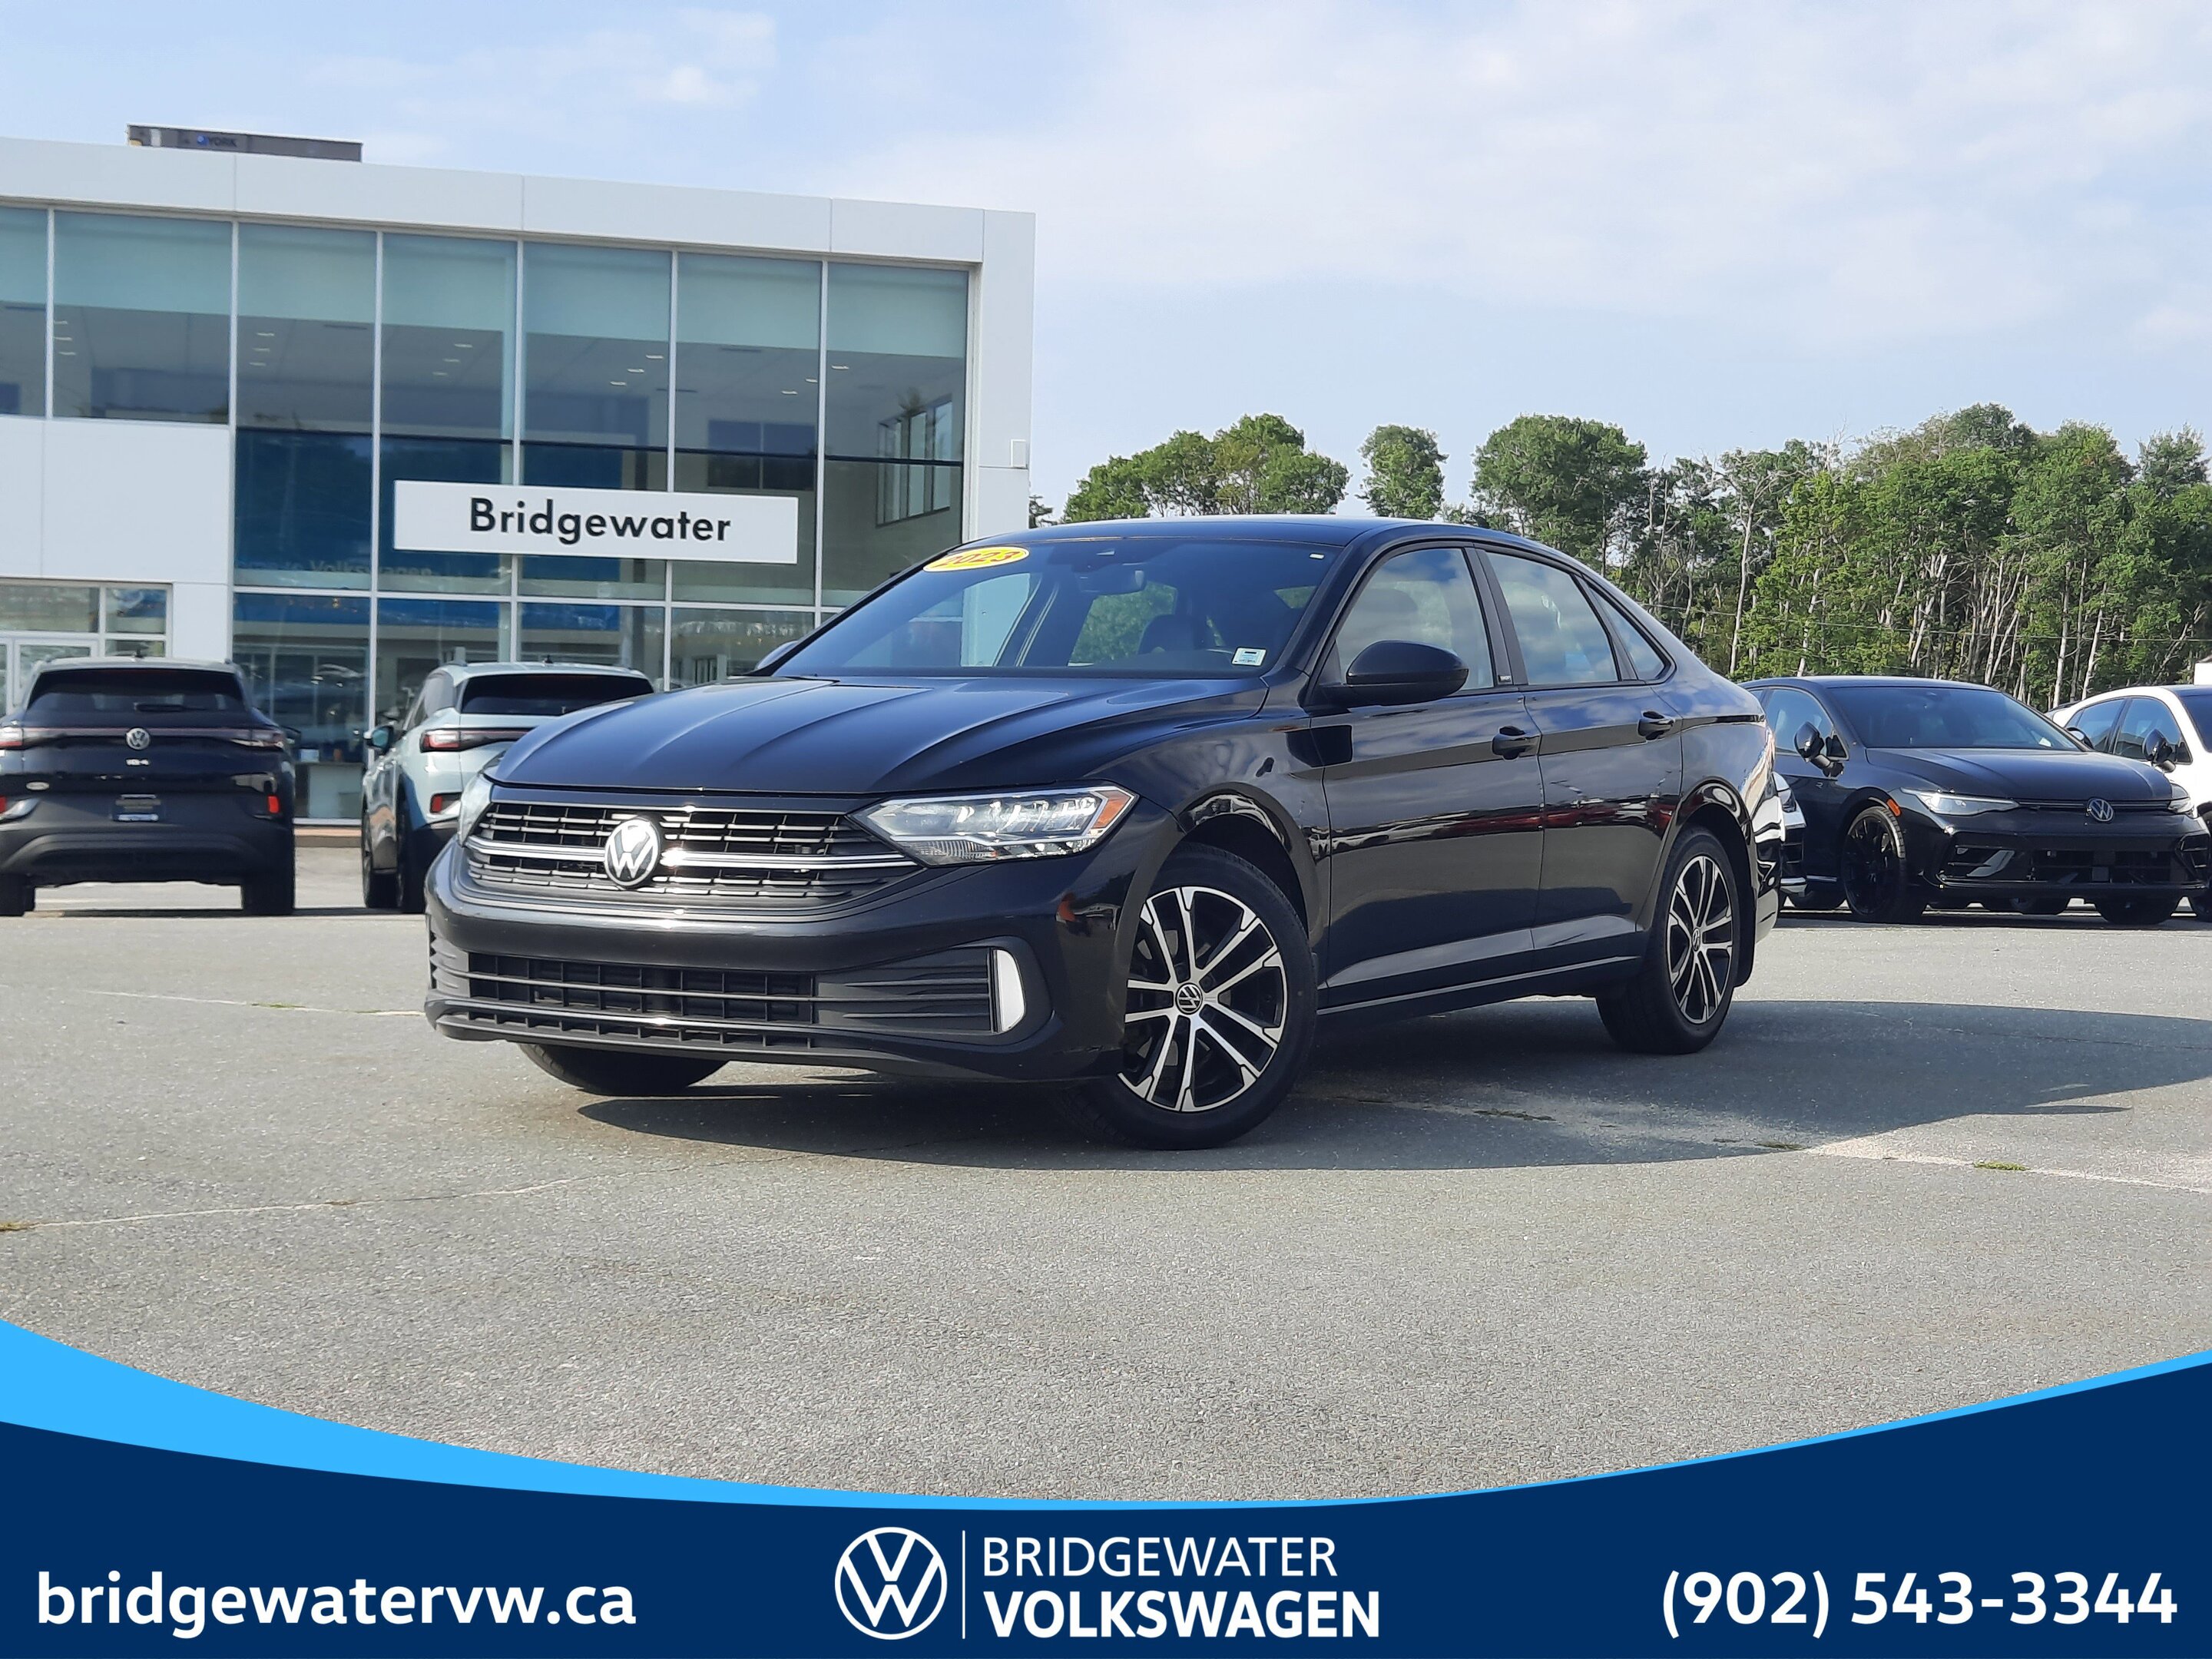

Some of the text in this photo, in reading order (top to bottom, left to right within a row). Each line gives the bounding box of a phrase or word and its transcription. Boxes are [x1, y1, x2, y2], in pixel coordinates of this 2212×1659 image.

[470, 497, 732, 545] Bridgewater
[308, 558, 434, 575] Volksagen
[932, 551, 1021, 568] 2023
